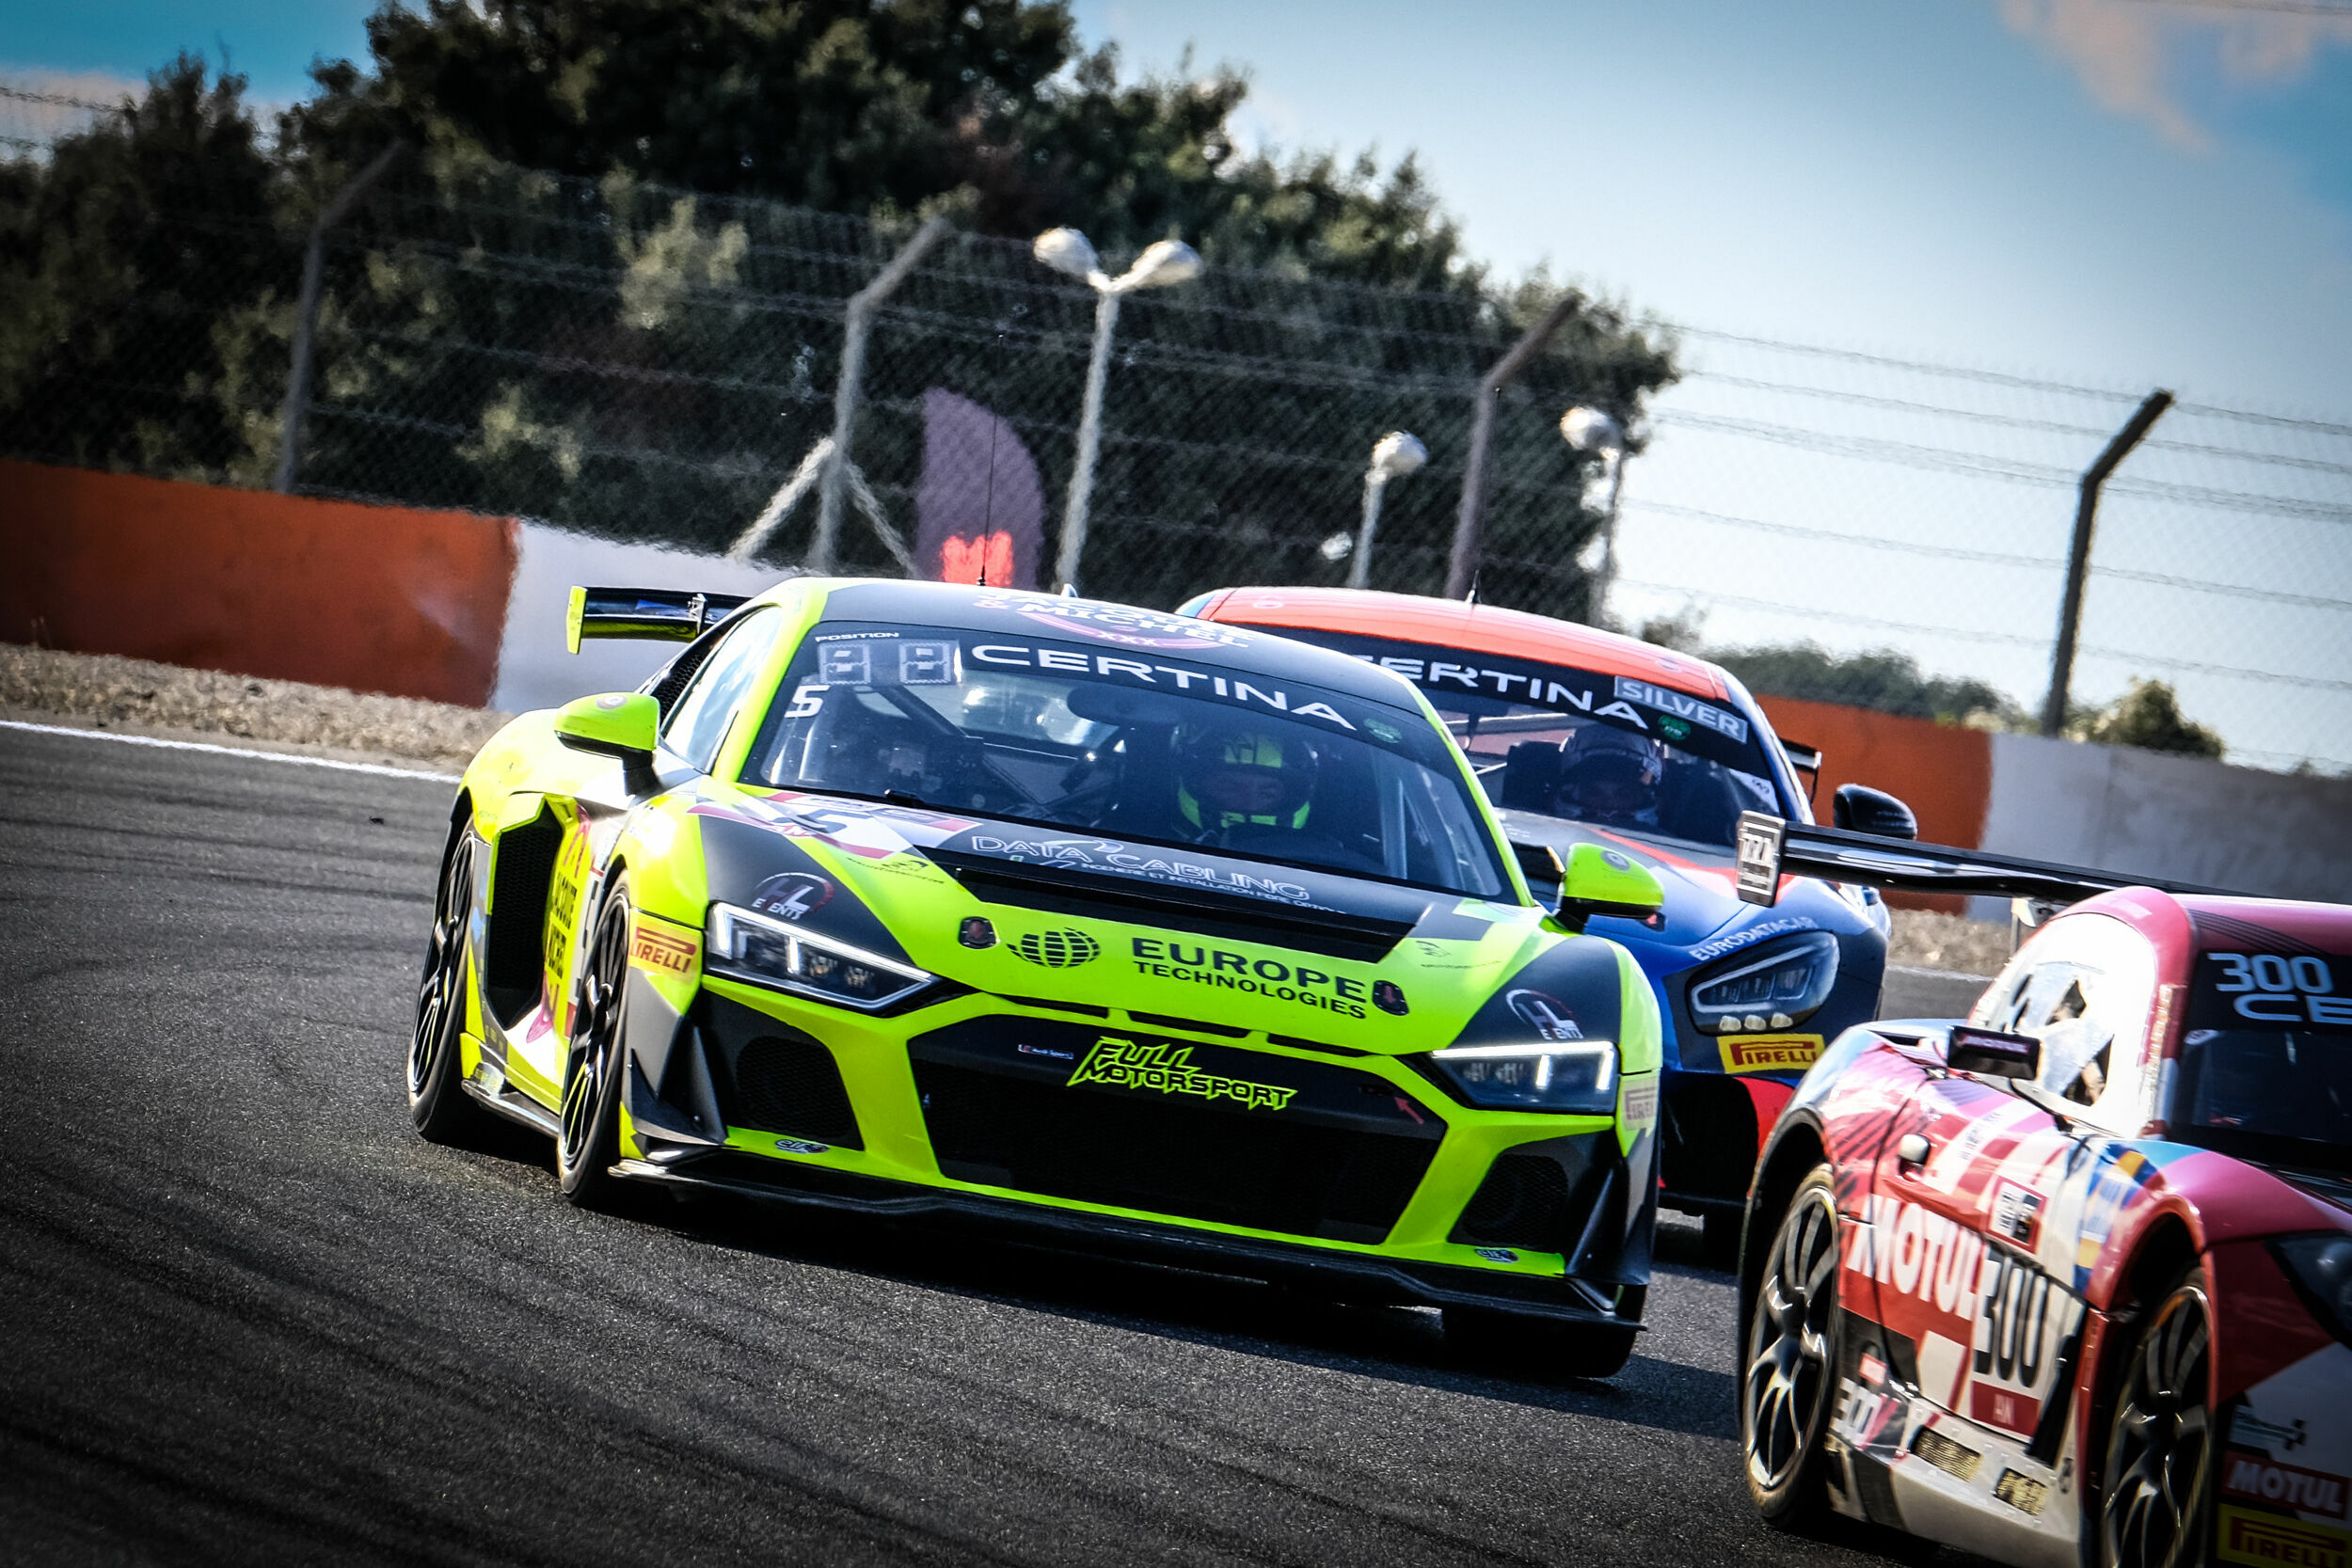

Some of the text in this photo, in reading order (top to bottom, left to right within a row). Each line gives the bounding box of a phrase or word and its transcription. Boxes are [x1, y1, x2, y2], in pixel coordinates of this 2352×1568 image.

[815, 632, 899, 642] POSITION
[1016, 604, 1249, 647] MICHEL
[785, 685, 832, 718] 5
[971, 644, 1358, 731] CERTINA
[1353, 655, 1649, 730] ERTINA
[1619, 677, 1740, 736] SILVER
[971, 835, 1311, 900] DATA CABLING
[1168, 875, 1255, 896] INSTALLATION
[1689, 916, 1820, 961] EURODATACAR
[1131, 937, 1367, 1004] EUROPE
[1133, 960, 1367, 1020] TECHNOLOGIES
[2207, 952, 2335, 994] 300
[1080, 1036, 1203, 1075] FULL
[1068, 1065, 1298, 1111] MOTORSPORT
[1846, 1193, 1982, 1323] MOTUL
[2227, 1459, 2342, 1513] MOTUL
